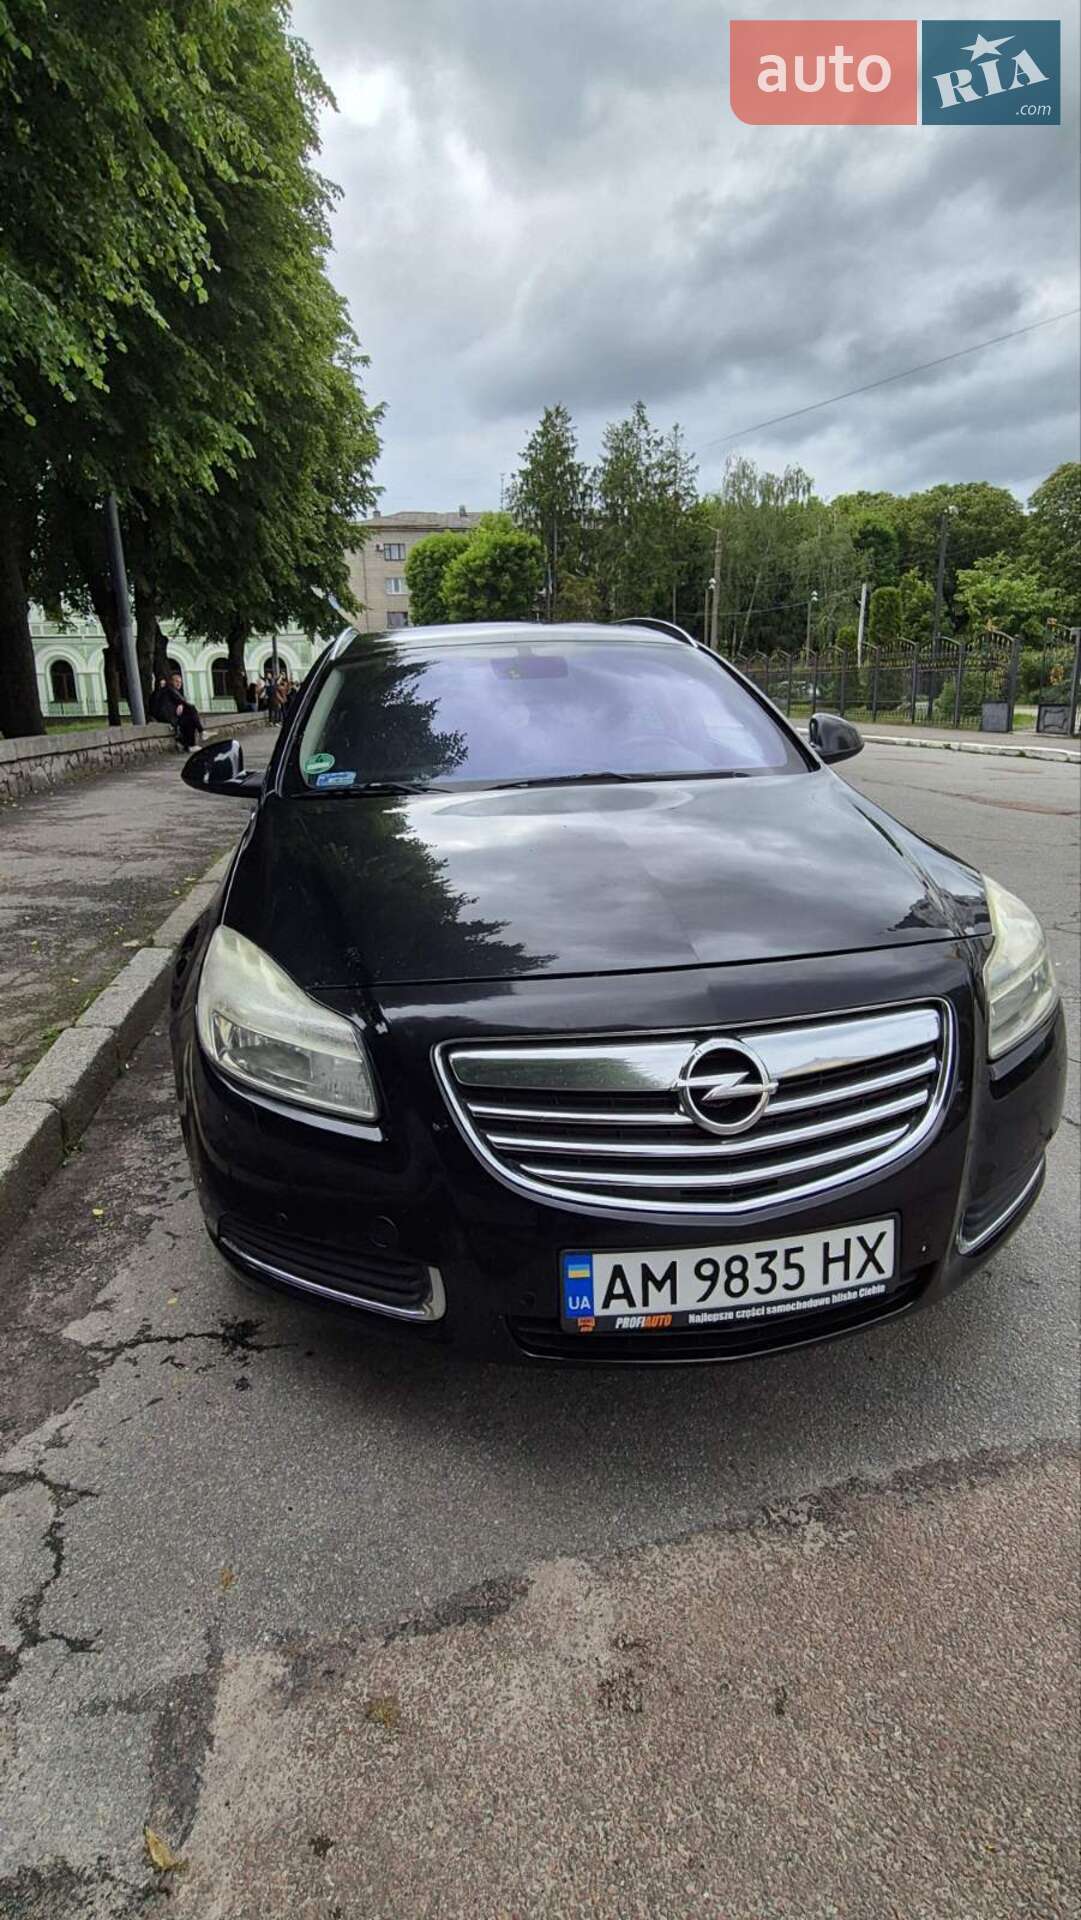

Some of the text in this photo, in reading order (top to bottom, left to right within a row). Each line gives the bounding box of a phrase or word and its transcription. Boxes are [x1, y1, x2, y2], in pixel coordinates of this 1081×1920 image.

[601, 1231, 888, 1310] AM 9835 HX
[568, 1295, 591, 1311] UA
[615, 1314, 673, 1330] PROFIAUTO
